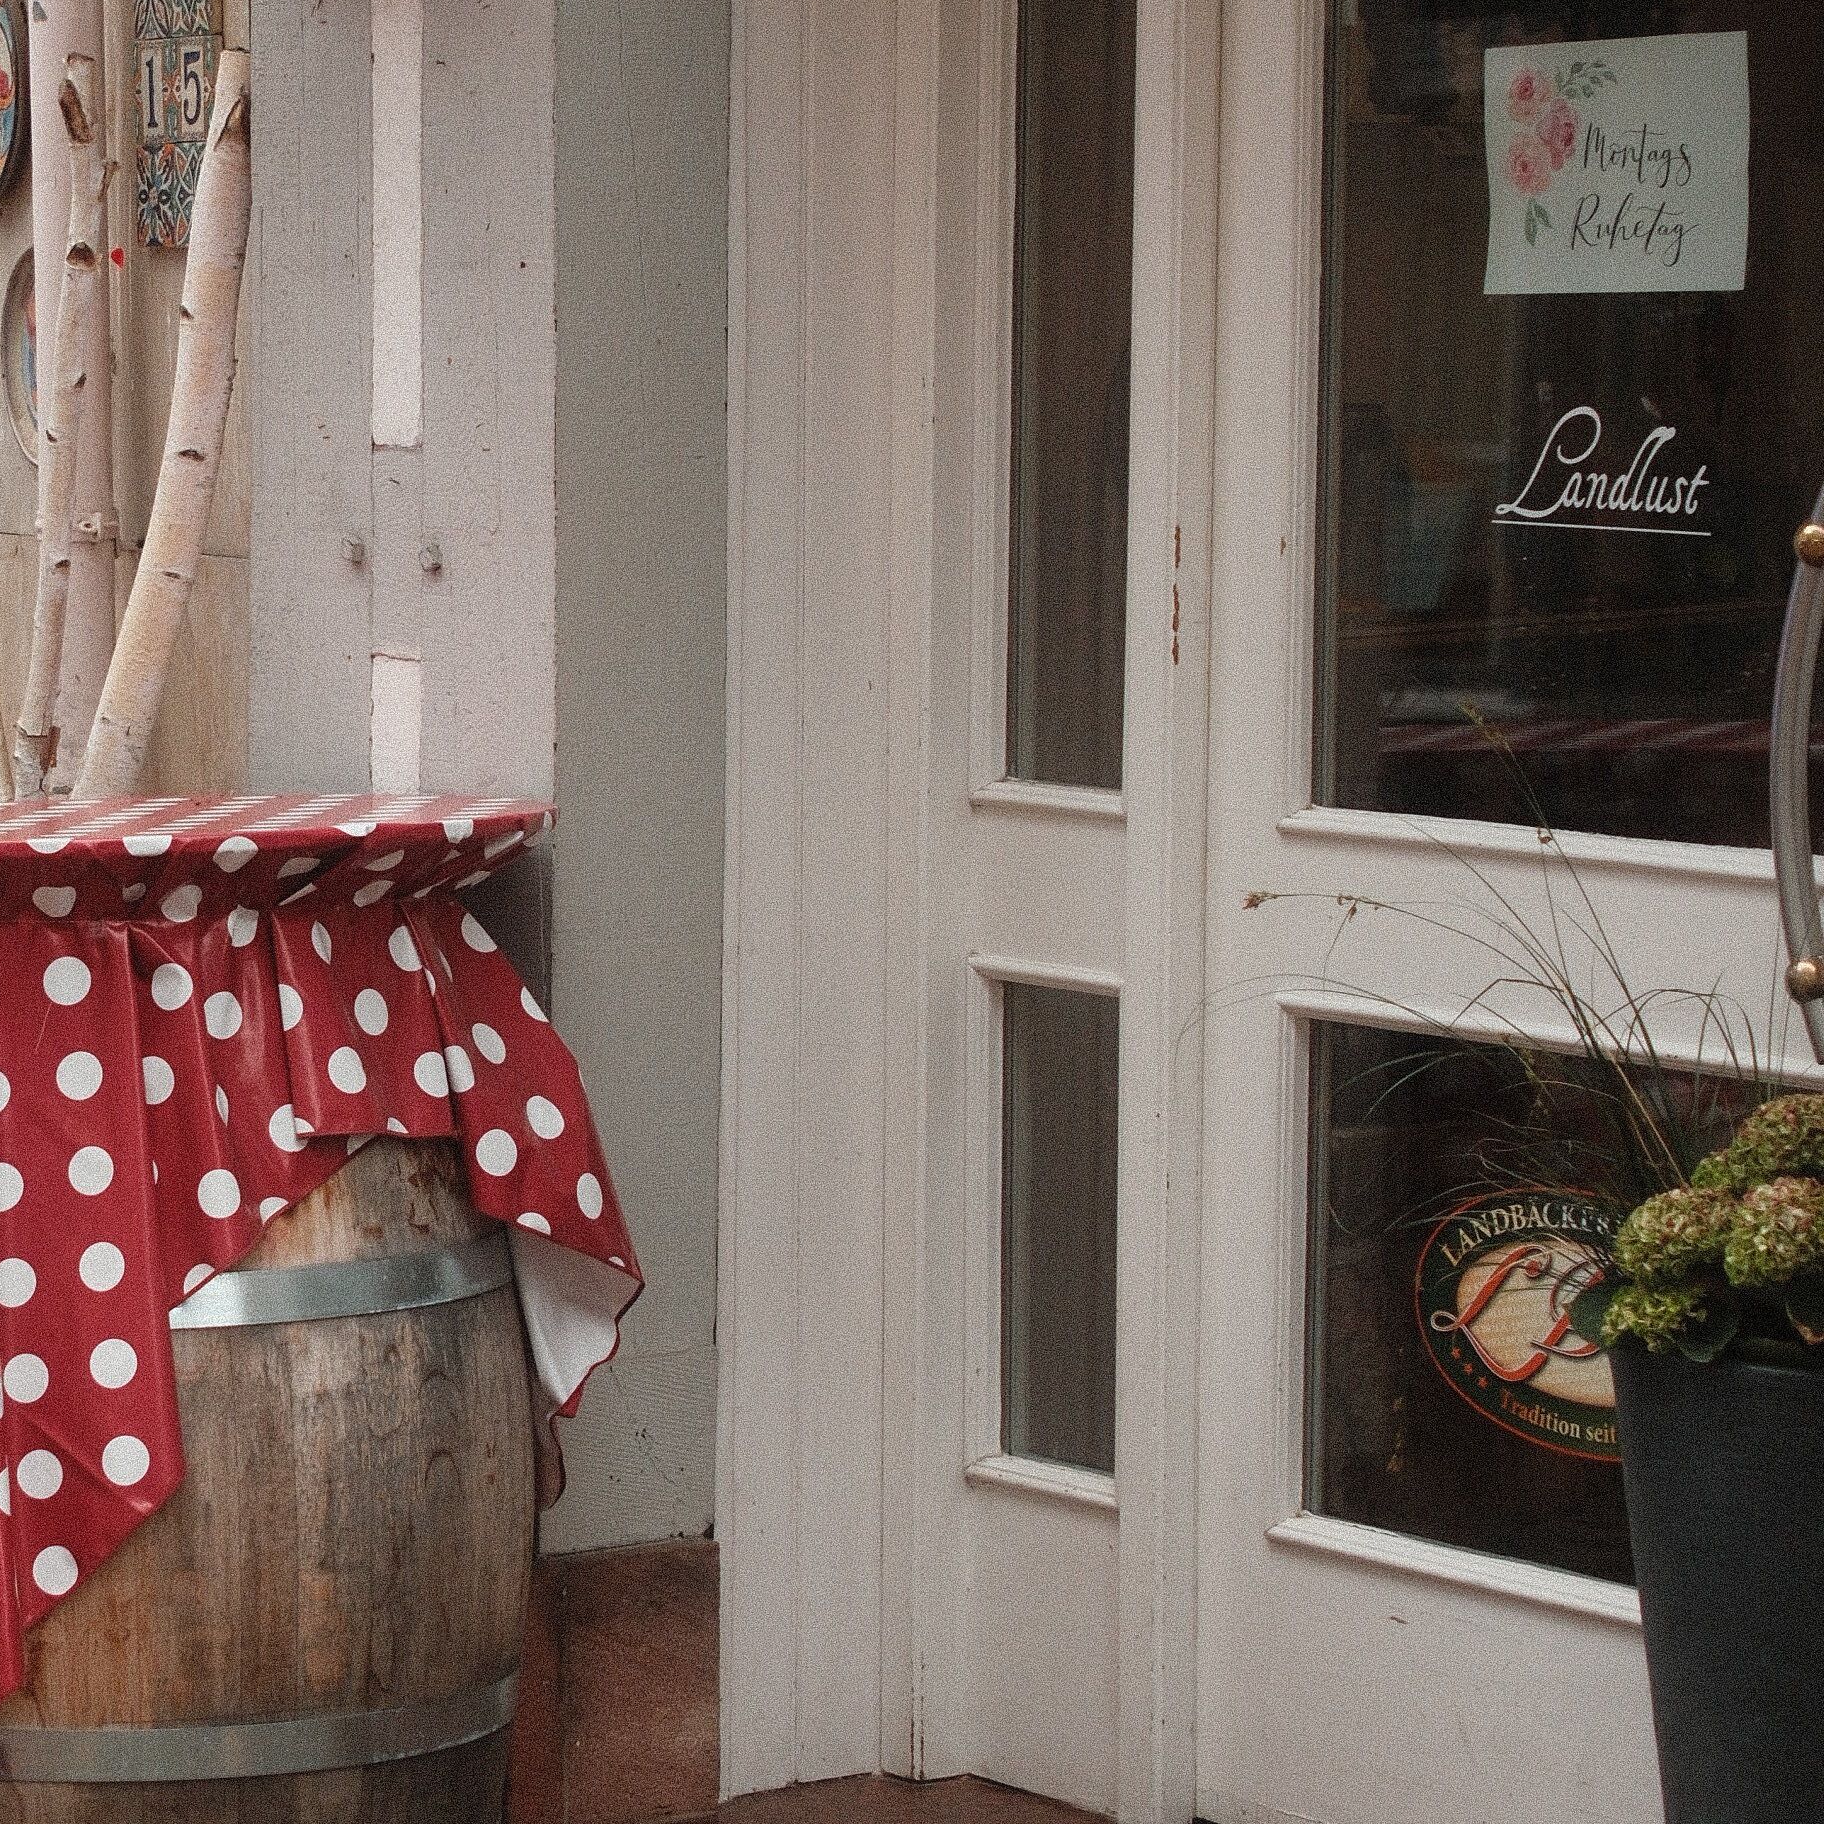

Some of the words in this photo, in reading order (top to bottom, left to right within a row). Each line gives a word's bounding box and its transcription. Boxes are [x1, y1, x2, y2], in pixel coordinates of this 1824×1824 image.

[145, 51, 202, 127] 15
[1583, 122, 1692, 188] Montags
[1572, 193, 1699, 267] Ruhetag
[1495, 407, 1710, 518] Landlust
[1500, 1388, 1581, 1440] Tradition
